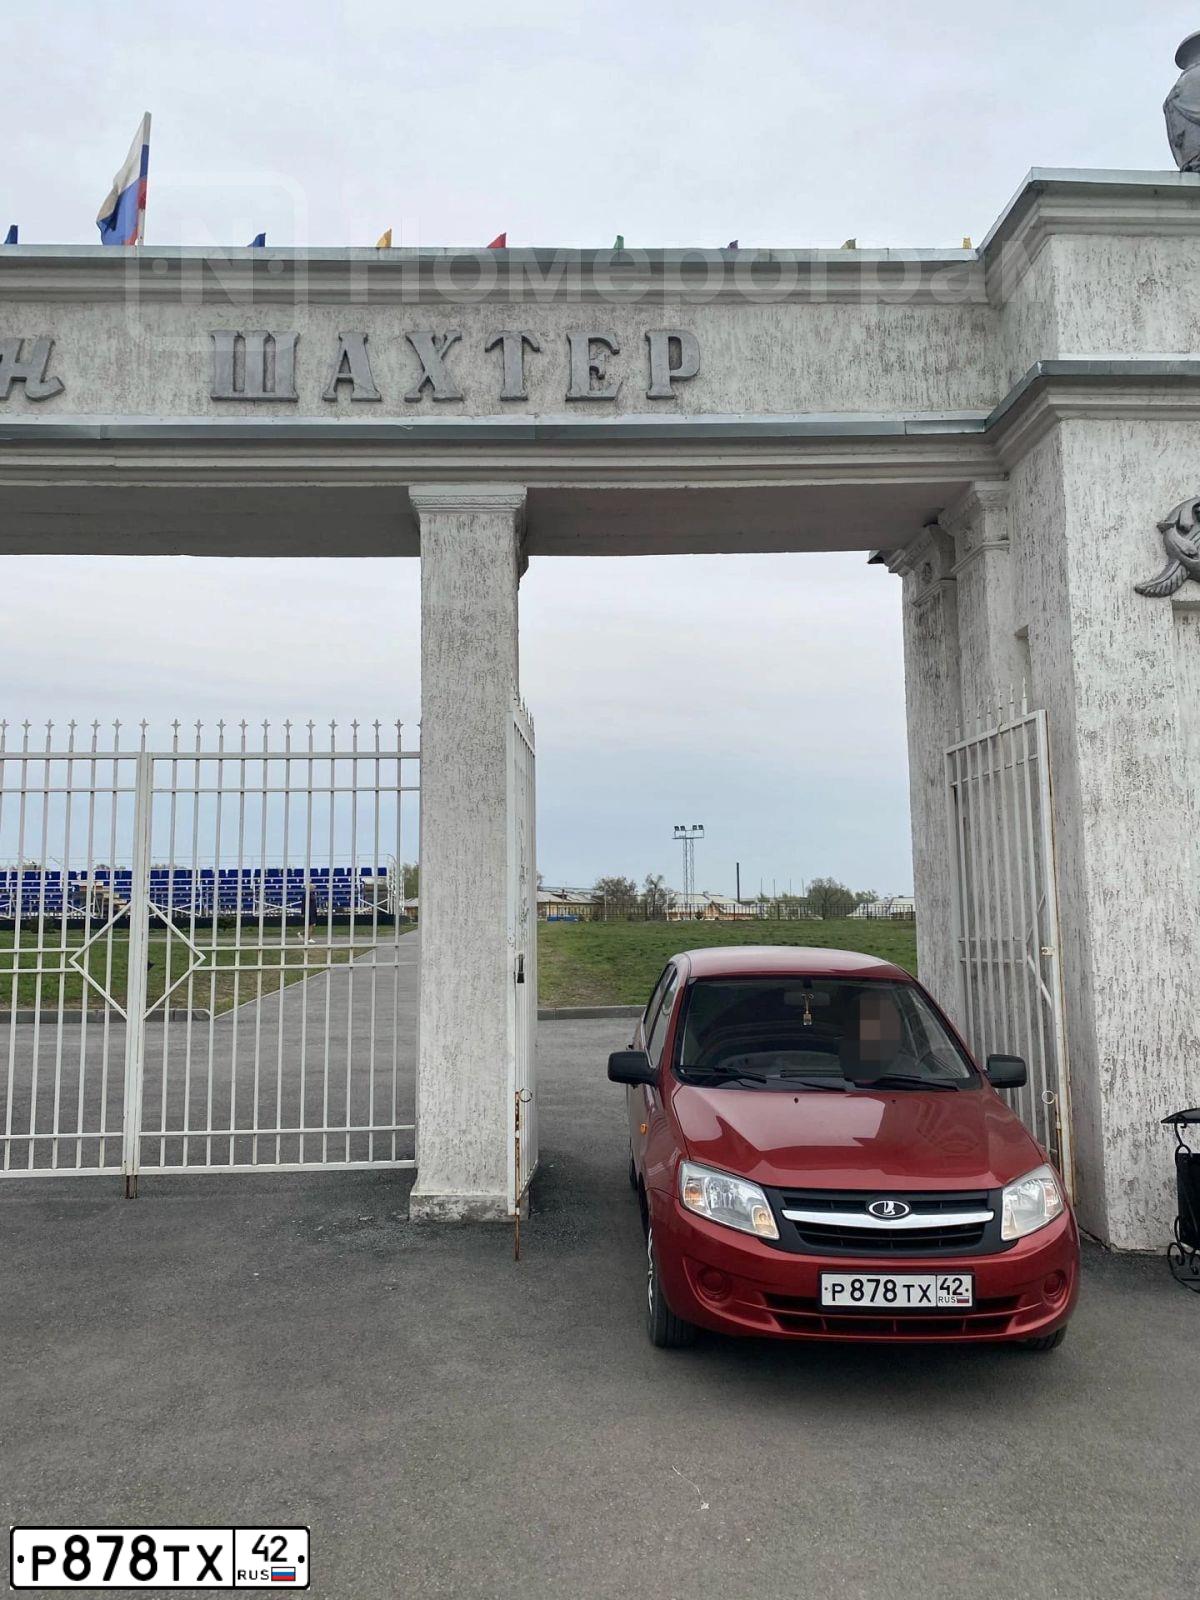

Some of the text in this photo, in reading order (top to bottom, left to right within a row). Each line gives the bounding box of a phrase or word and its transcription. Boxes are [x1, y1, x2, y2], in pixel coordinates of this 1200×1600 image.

[210, 329, 700, 403] ШАХТЕР
[938, 1277, 963, 1296] 42
[938, 1296, 956, 1304] RUS
